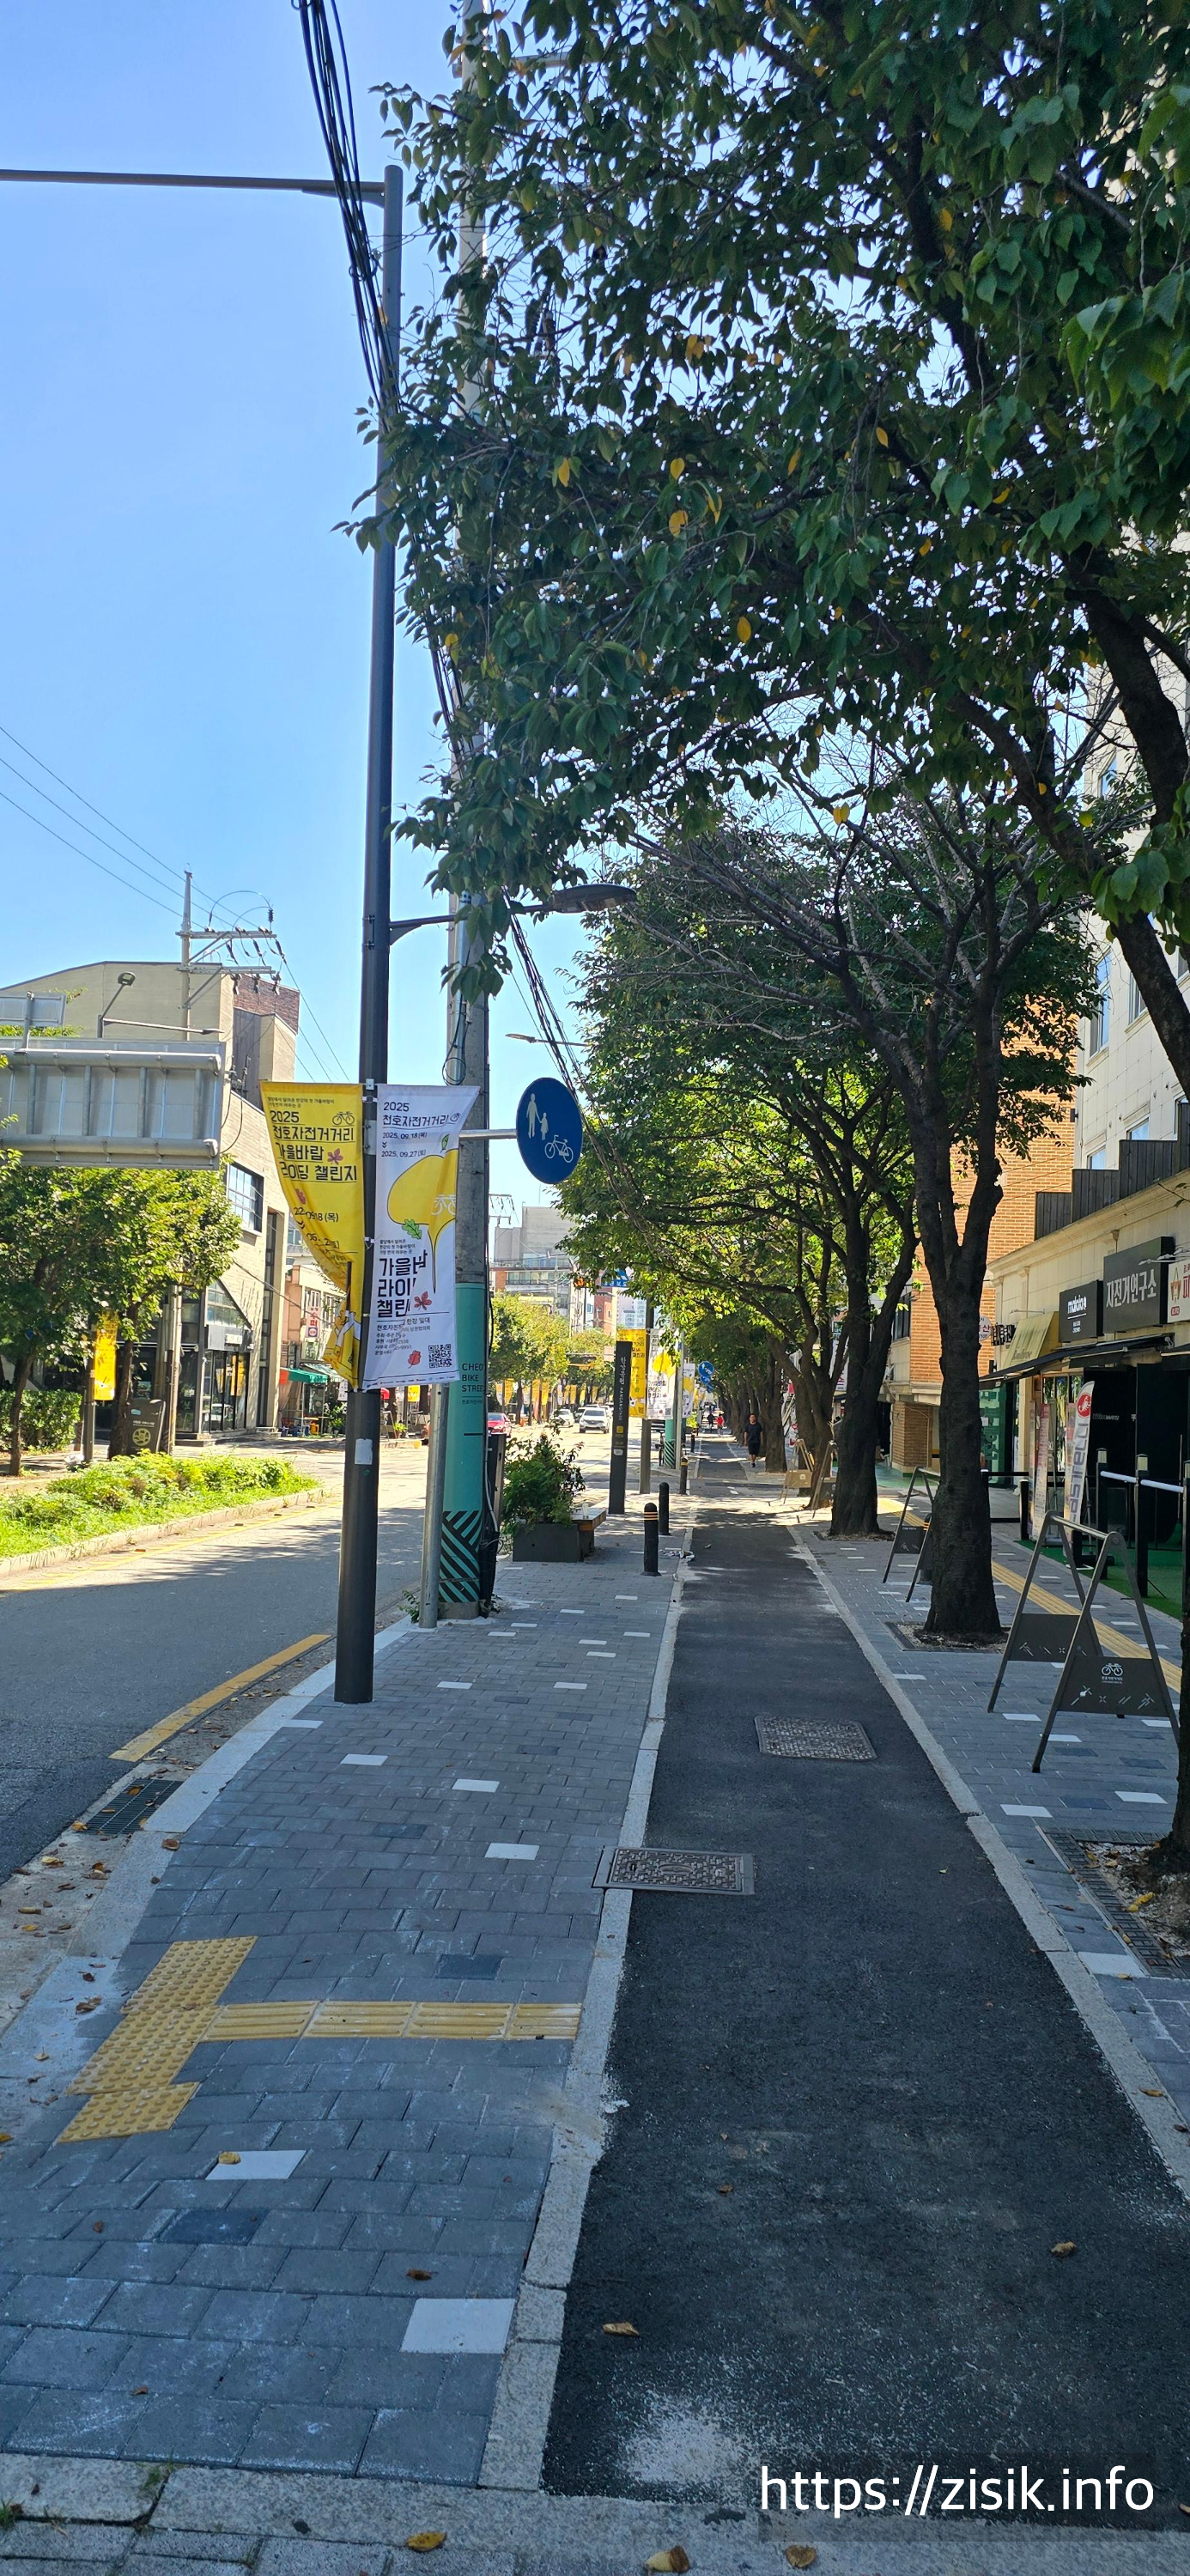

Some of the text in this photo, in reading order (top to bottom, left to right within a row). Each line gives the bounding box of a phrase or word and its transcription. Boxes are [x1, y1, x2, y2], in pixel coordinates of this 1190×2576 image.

[383, 1102, 410, 1112] 2025
[270, 1110, 300, 1123] 2025
[383, 1115, 449, 1127] 천호자전거거리
[273, 1125, 354, 1141] 천호자전거거리
[275, 1142, 325, 1161] 가을바람
[314, 1165, 357, 1182] 챌린지
[1106, 1268, 1157, 1309] 자전거연구소
